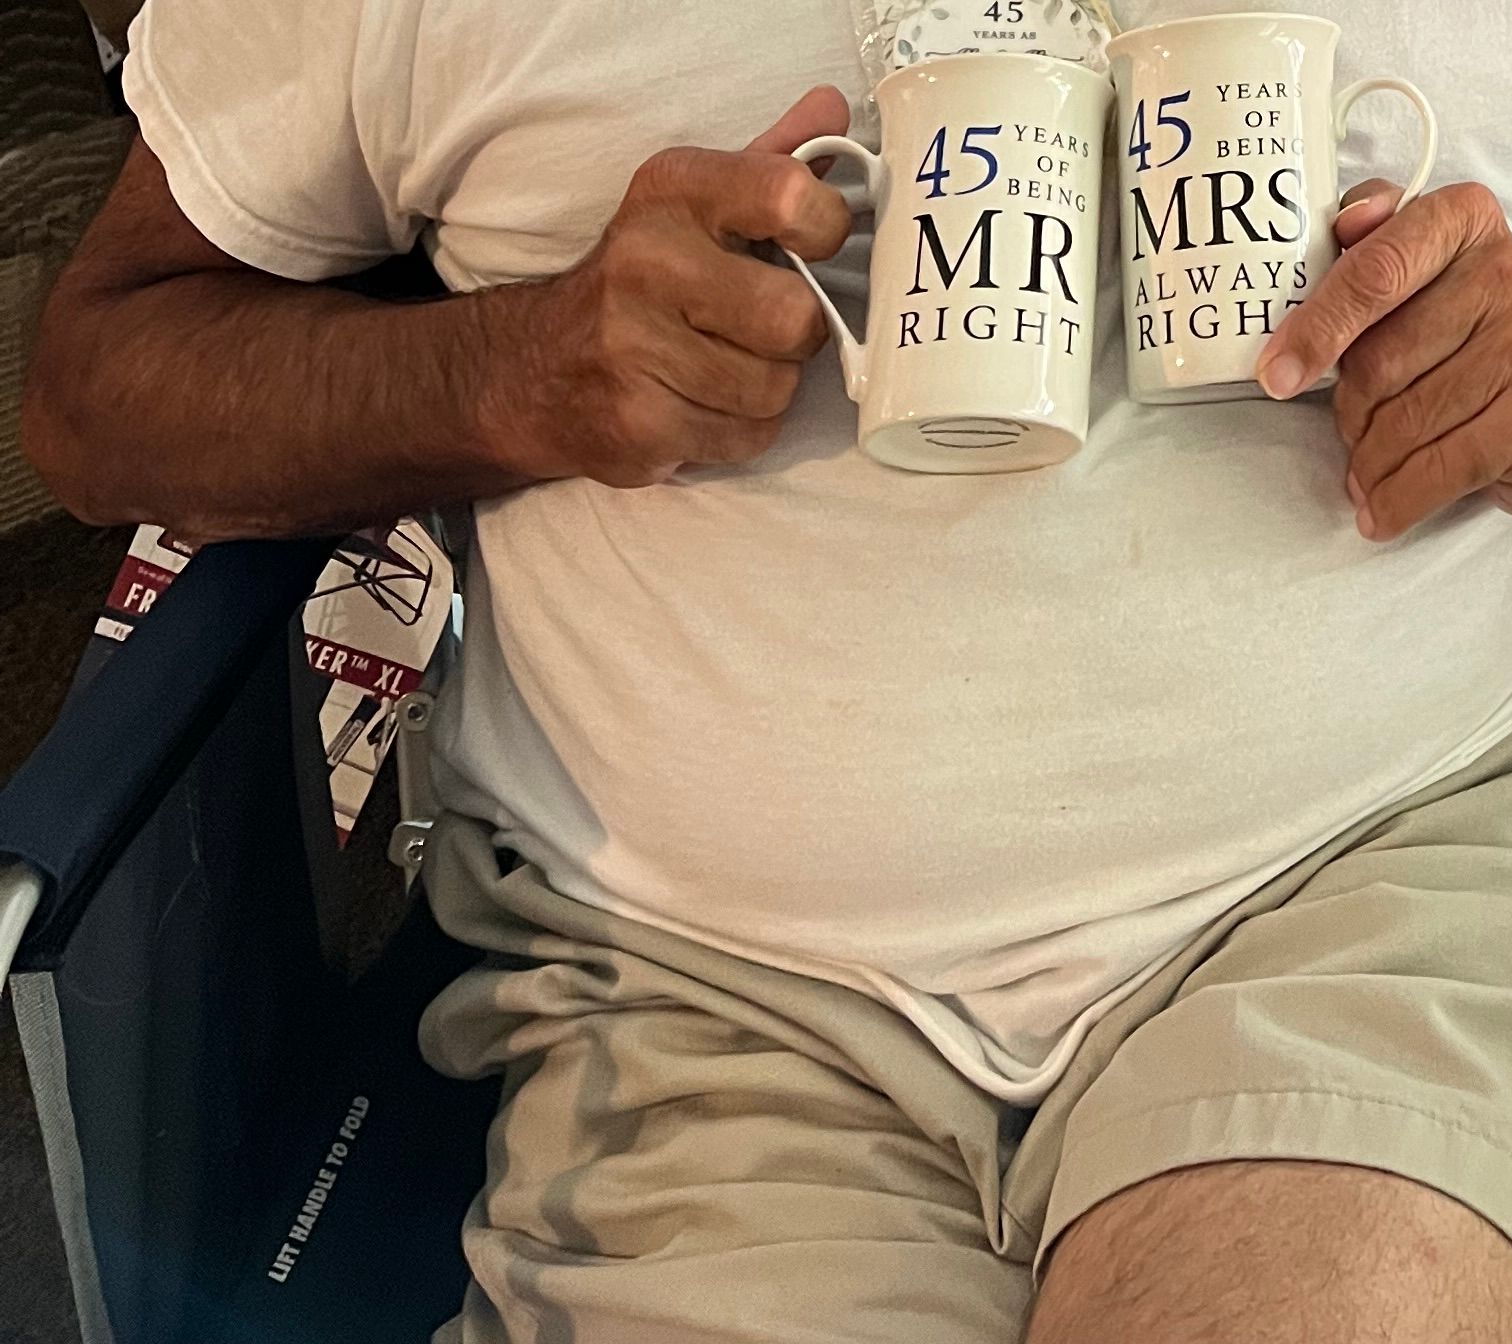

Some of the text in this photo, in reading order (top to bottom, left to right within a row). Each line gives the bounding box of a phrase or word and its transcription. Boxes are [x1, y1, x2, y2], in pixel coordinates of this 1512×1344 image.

[983, 0, 1024, 24] 45
[972, 30, 1037, 40] YEARS AS
[1216, 82, 1303, 103] YEARS
[1128, 89, 1192, 173] 45
[1244, 110, 1281, 128] OF
[1013, 123, 1090, 158] YEARS
[1216, 137, 1305, 158] BEING
[914, 124, 1003, 200] 45
[1036, 155, 1070, 177] OF
[1006, 178, 1087, 213] BEING
[1130, 167, 1307, 262] MRS
[905, 209, 1079, 305] MR
[1134, 260, 1307, 308] ALWAYS
[896, 304, 1081, 355] RIGHT
[372, 663, 404, 696] XL
[268, 1096, 370, 1283] LIFT HANDLE TO FOLD
